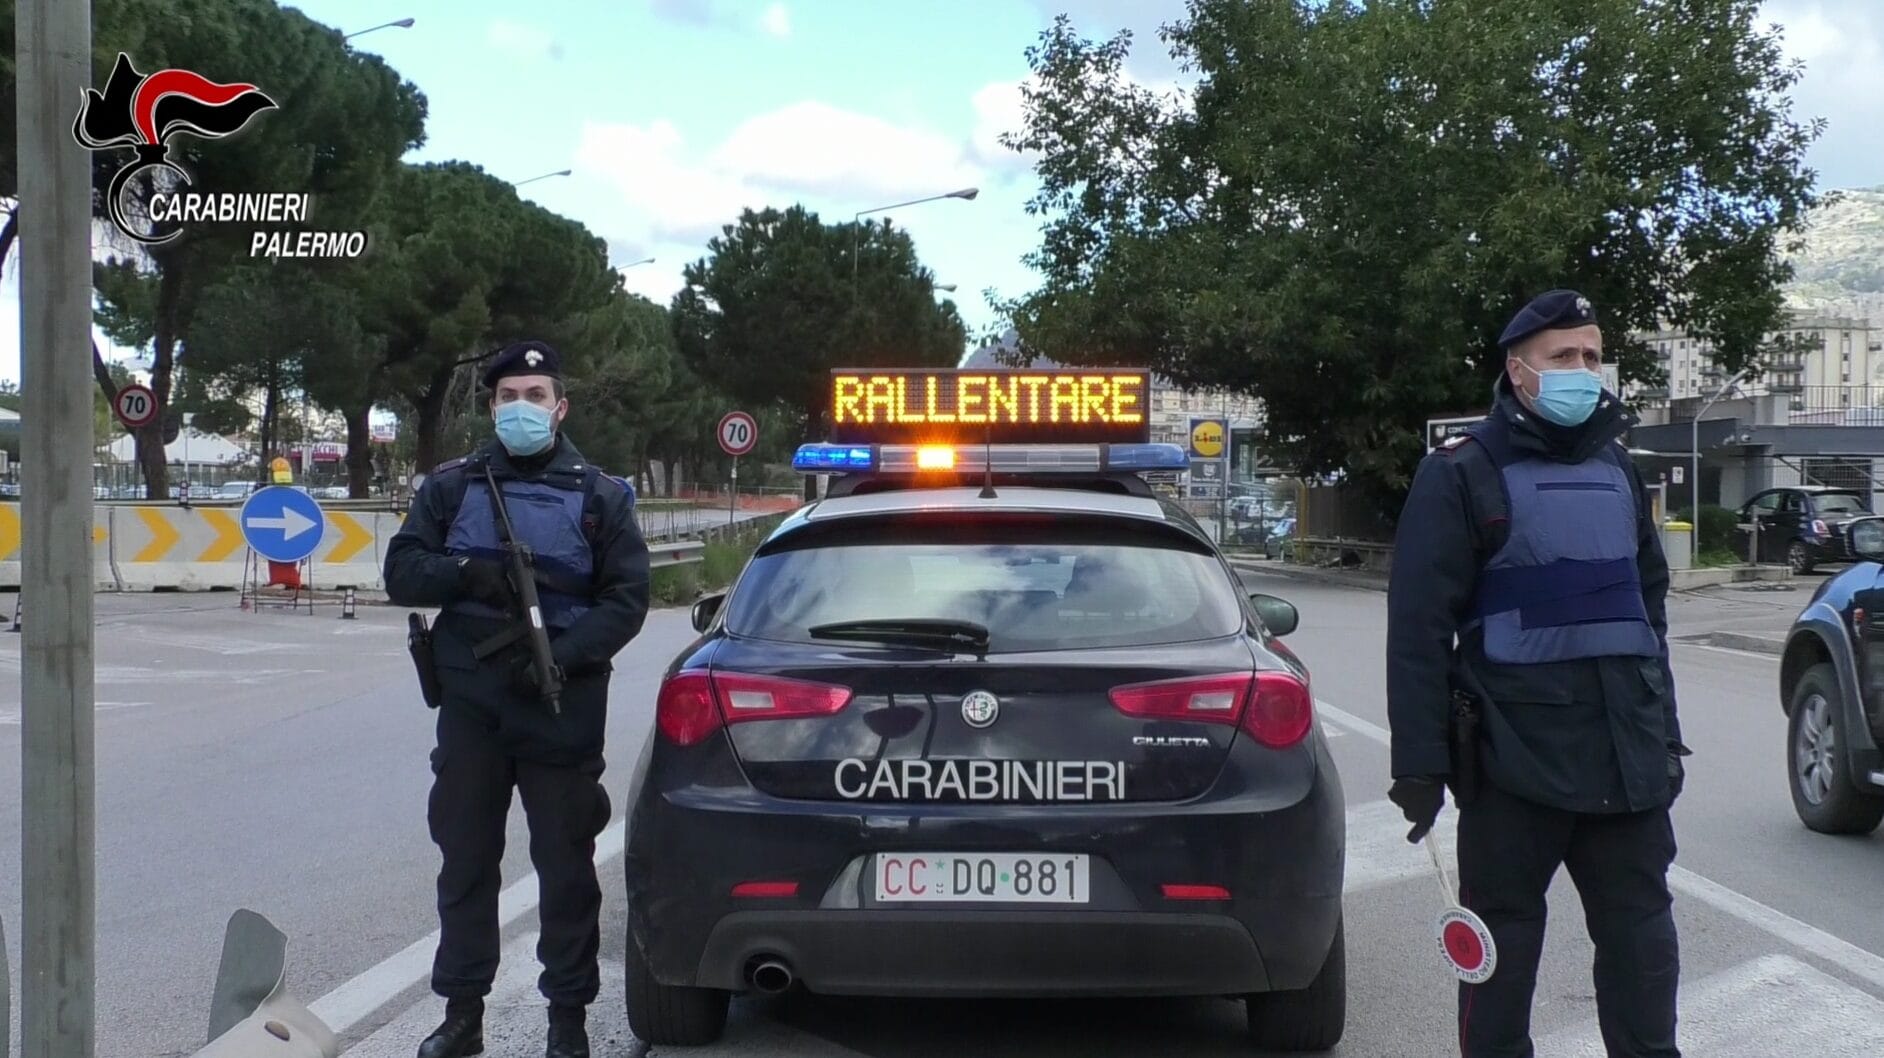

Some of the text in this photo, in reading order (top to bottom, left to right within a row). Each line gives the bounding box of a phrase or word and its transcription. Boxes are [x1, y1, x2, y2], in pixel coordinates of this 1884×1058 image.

[125, 395, 146, 414] 70
[835, 376, 1142, 423] RALLENTARE
[727, 423, 748, 443] 70
[1132, 736, 1211, 748] GIULIETTA
[833, 757, 1126, 800] CARABINIERI
[885, 858, 1076, 900] CC DQ 881
